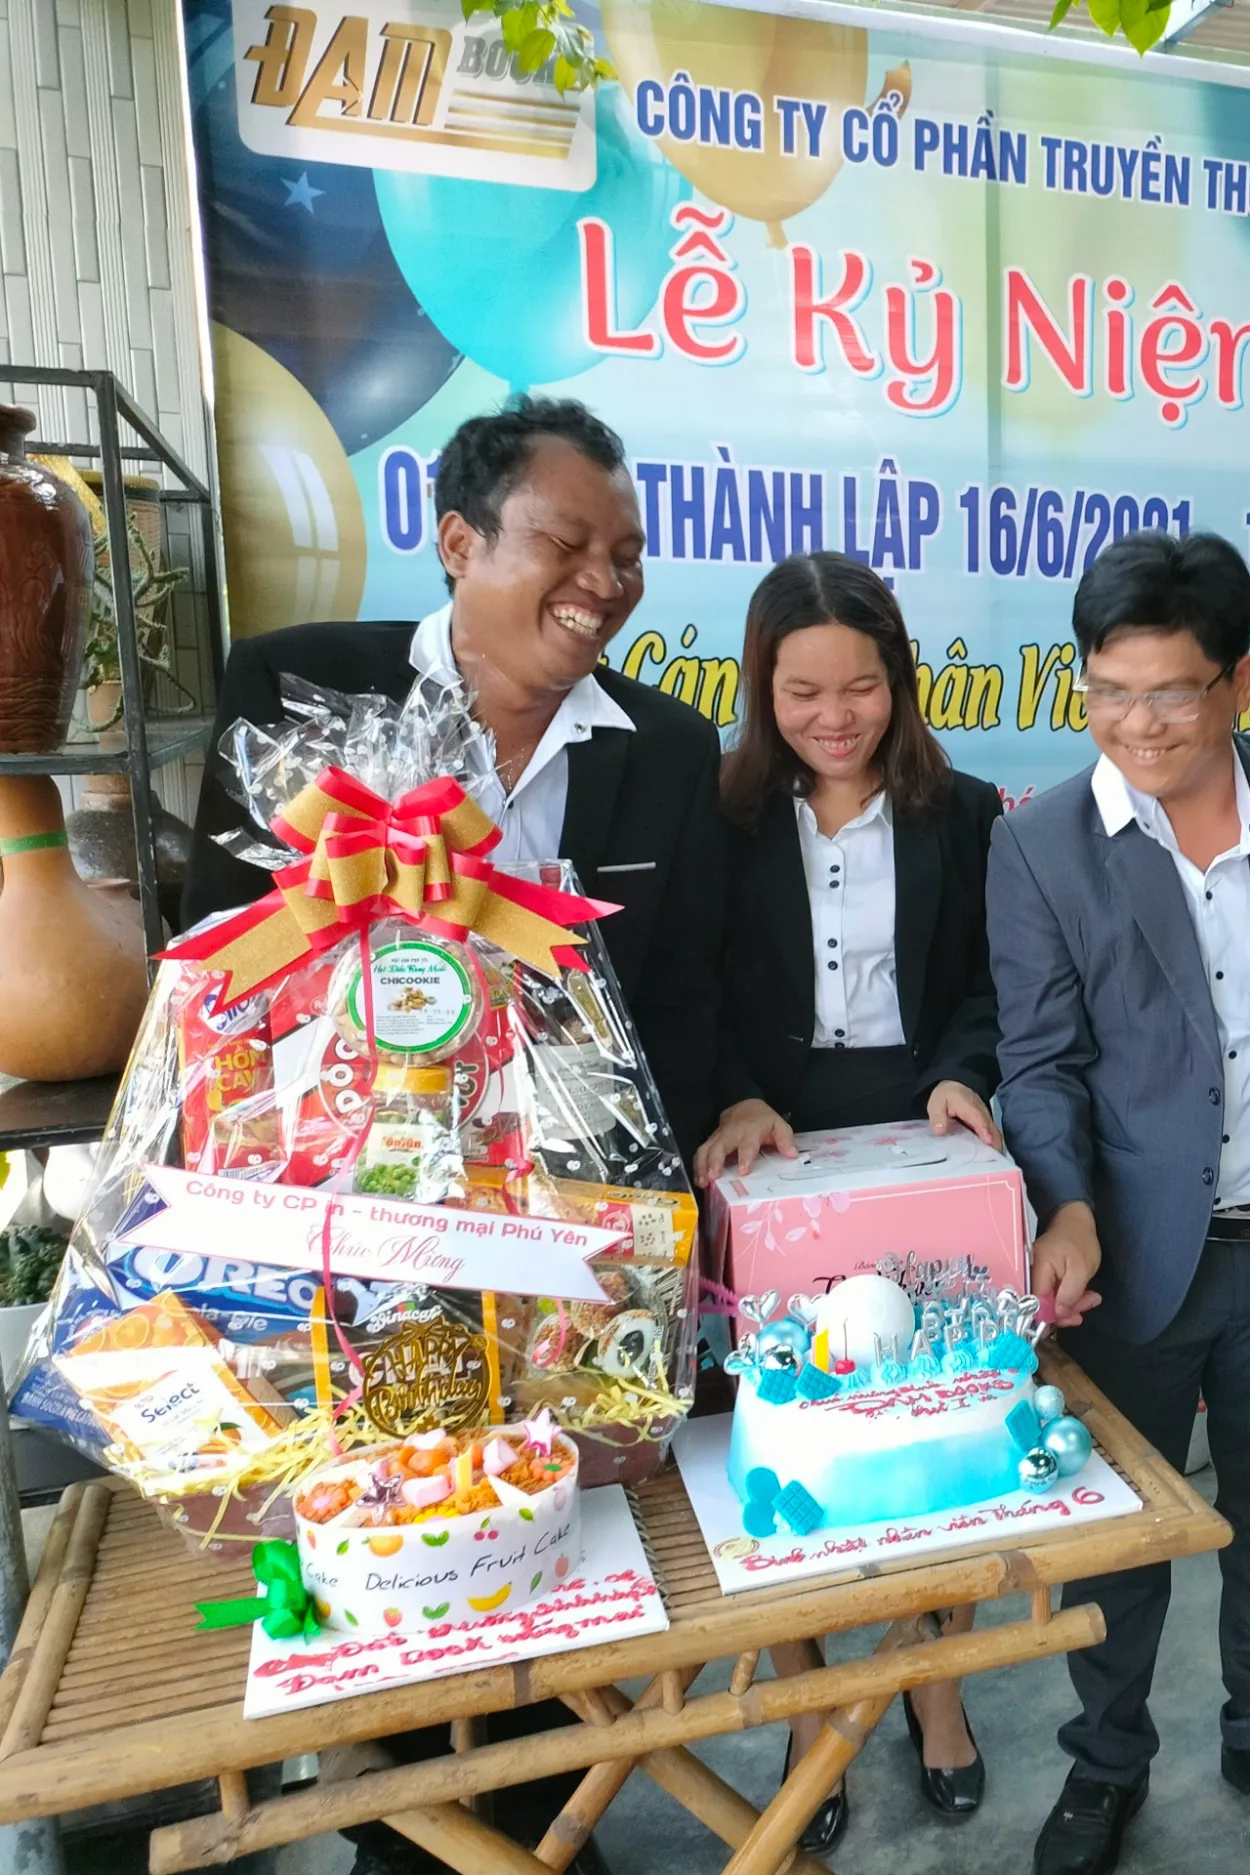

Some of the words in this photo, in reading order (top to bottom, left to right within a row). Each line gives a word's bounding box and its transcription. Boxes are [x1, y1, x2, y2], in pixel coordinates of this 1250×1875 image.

[636, 74, 761, 150] CÔNG
[777, 99, 826, 157] TY
[843, 92, 898, 167] CỔ
[914, 110, 1026, 184] PHẦN
[1042, 135, 1190, 206] TRUYỀN
[578, 206, 740, 361] Lễ
[789, 246, 957, 413] Kỷ
[637, 446, 822, 563] THÀNH
[843, 458, 940, 590] LẬP
[908, 637, 1003, 731] hân
[380, 977, 440, 985] CHICOOKIE
[186, 1180, 244, 1205] Công
[253, 1191, 276, 1210] ty
[283, 1194, 317, 1211] CP
[370, 1207, 449, 1235] thương
[456, 1219, 493, 1241] mại
[501, 1222, 543, 1243] Phú
[551, 1227, 588, 1247] Yên
[133, 1247, 316, 1310] OREO
[874, 1319, 998, 1367] HAPP
[1071, 1486, 1105, 1506] 6
[307, 1562, 339, 1588] Cake
[366, 1568, 459, 1591] Delicious
[470, 1550, 525, 1577] Fruit
[534, 1523, 570, 1556] Cake
